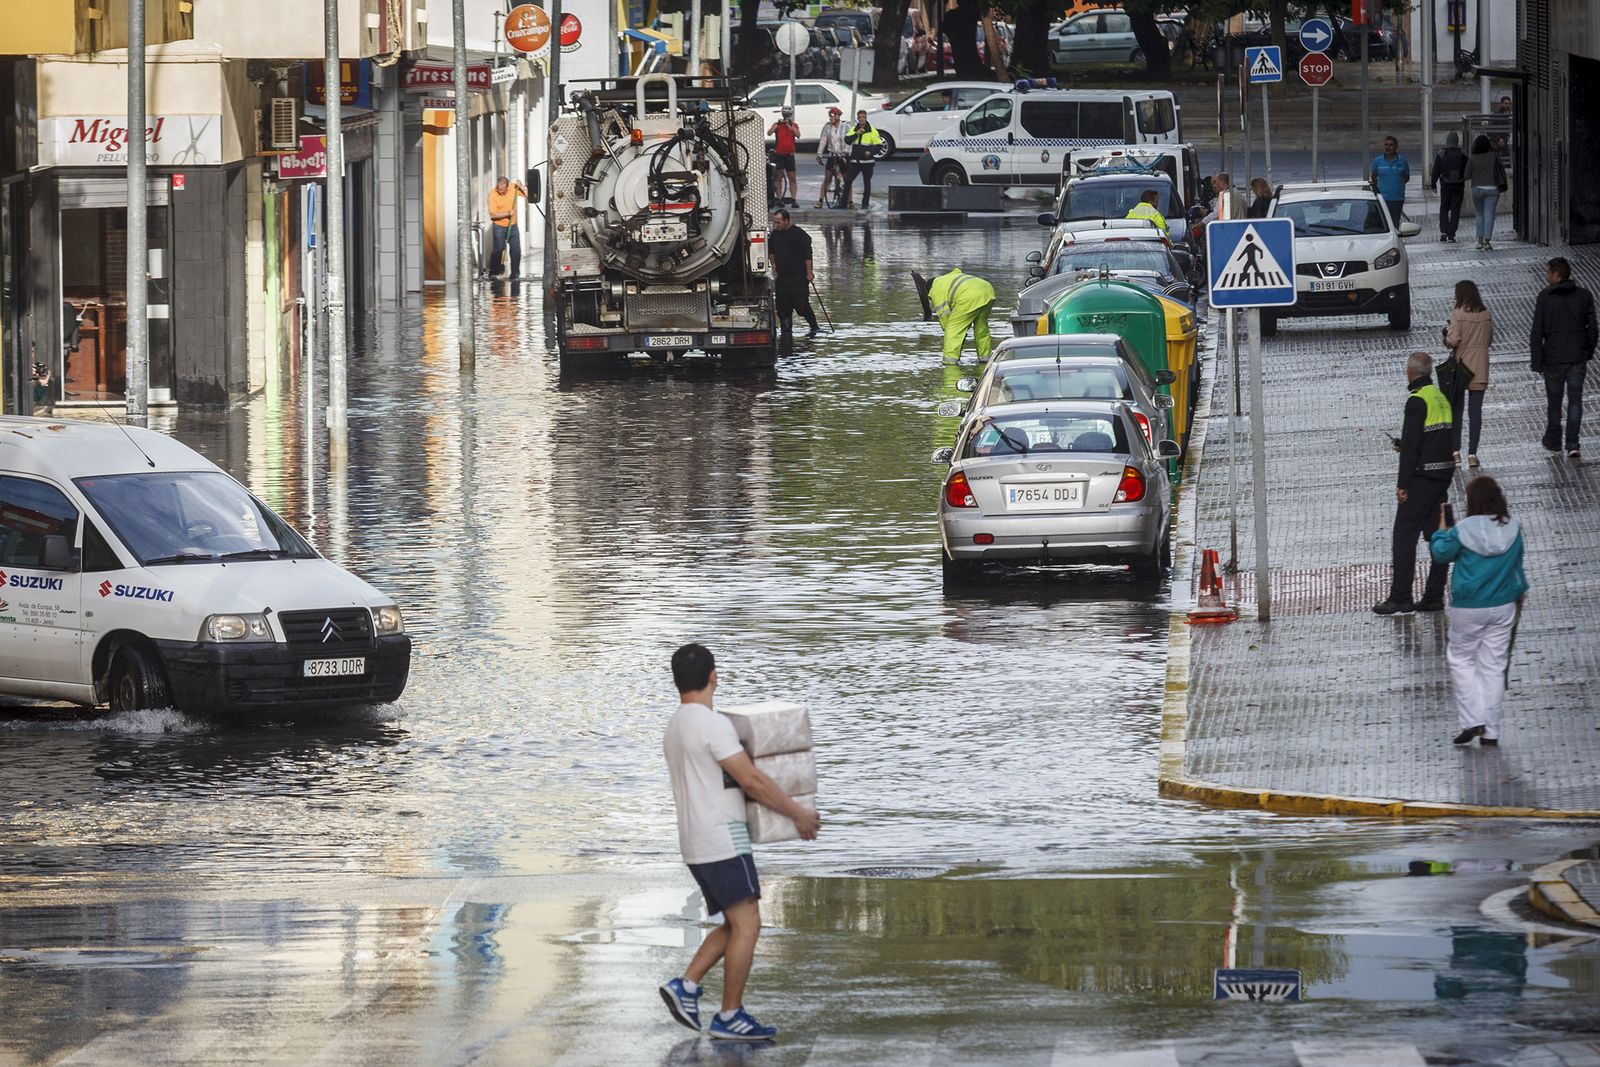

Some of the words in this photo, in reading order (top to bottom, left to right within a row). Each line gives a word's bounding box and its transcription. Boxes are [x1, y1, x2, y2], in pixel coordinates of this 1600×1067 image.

[507, 26, 549, 39] Cruzcampo
[406, 67, 488, 84] Firestne
[1302, 64, 1330, 73] STOP
[68, 117, 165, 151] Migel
[1315, 282, 1335, 291] 9191
[1338, 281, 1354, 290] GVH
[674, 336, 690, 345] DRH
[1017, 489, 1049, 501] 7654
[1054, 488, 1078, 501] DDJ
[9, 575, 63, 591] SUZUKI
[114, 584, 175, 602] SUZUKI
[310, 660, 338, 675] 8733
[341, 659, 361, 673] DDR
